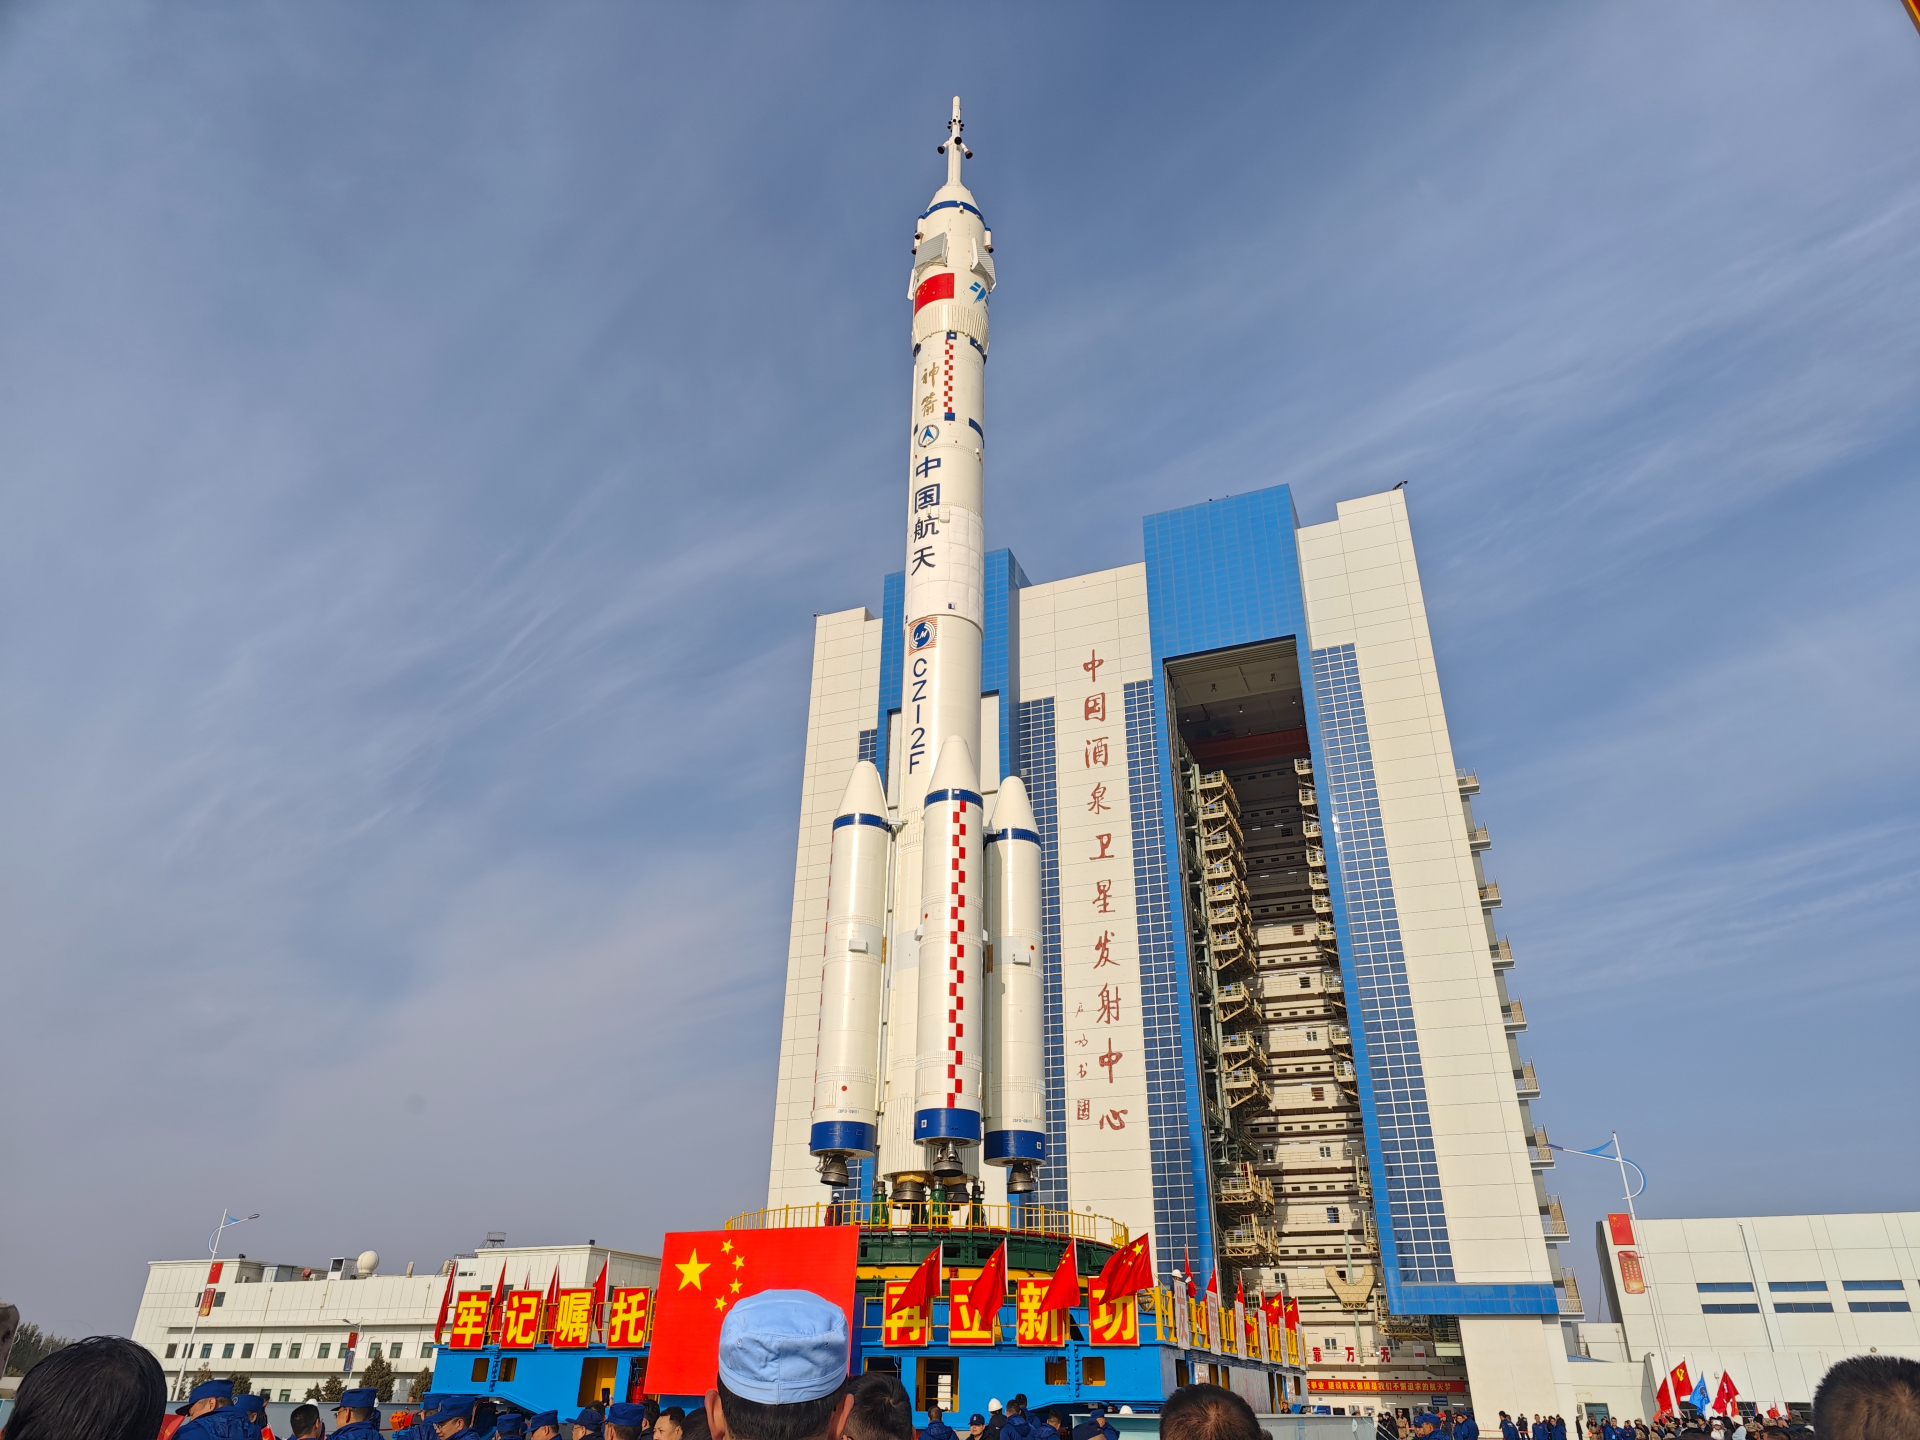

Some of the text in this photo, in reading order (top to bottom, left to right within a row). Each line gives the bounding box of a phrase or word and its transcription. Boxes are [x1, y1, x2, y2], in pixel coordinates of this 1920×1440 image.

[911, 456, 941, 576] 中国航天
[1083, 649, 1128, 1131] 中国酒泉卫星发射中心
[453, 1291, 647, 1346] 牢记嘱托
[885, 1282, 1135, 1342] 再立新功
